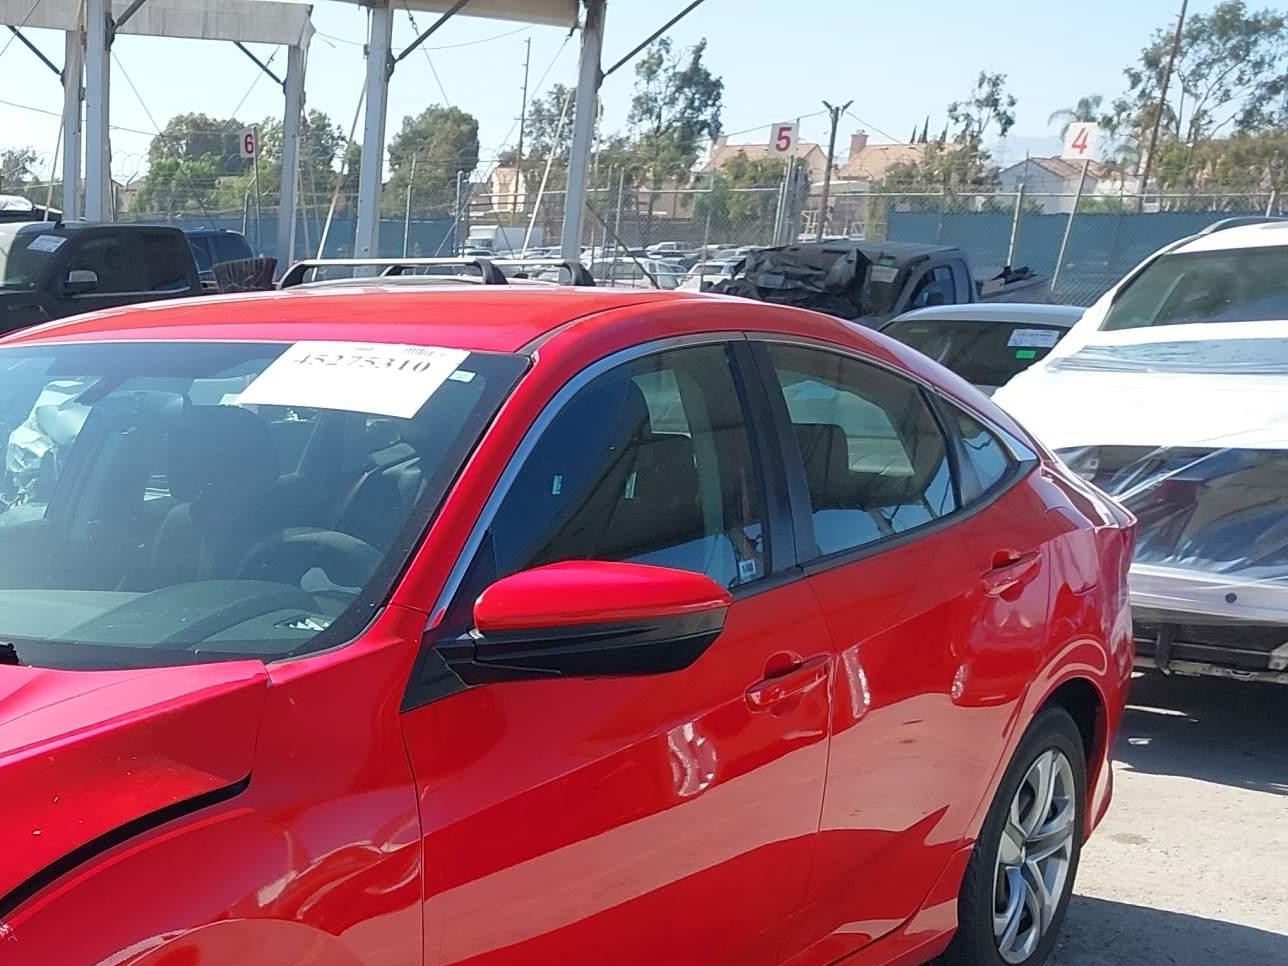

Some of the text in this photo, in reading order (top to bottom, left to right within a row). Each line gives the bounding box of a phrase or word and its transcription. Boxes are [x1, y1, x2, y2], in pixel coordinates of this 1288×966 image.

[244, 133, 254, 154] 6
[775, 126, 792, 152] 5
[1071, 127, 1089, 155] 4
[293, 353, 431, 373] 45275310
